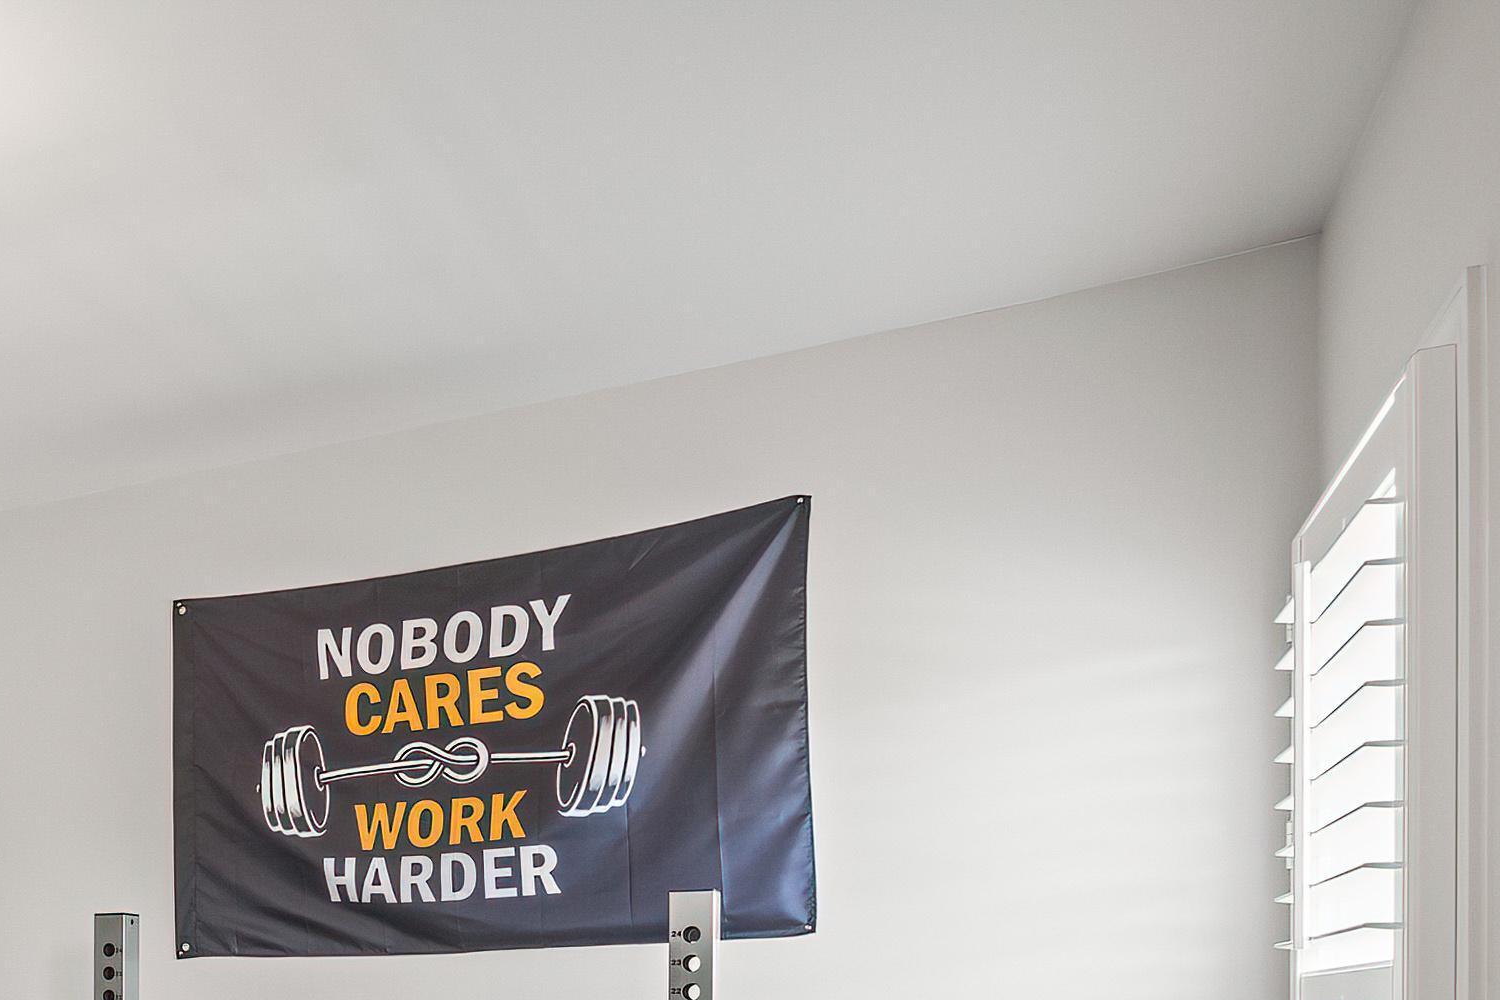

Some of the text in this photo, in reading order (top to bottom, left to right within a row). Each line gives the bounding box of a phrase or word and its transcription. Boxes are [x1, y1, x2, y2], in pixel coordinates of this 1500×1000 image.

[317, 594, 572, 680] NOBODY
[344, 662, 545, 736] CARES
[354, 789, 528, 851] WORK
[323, 844, 562, 904] HARDER
